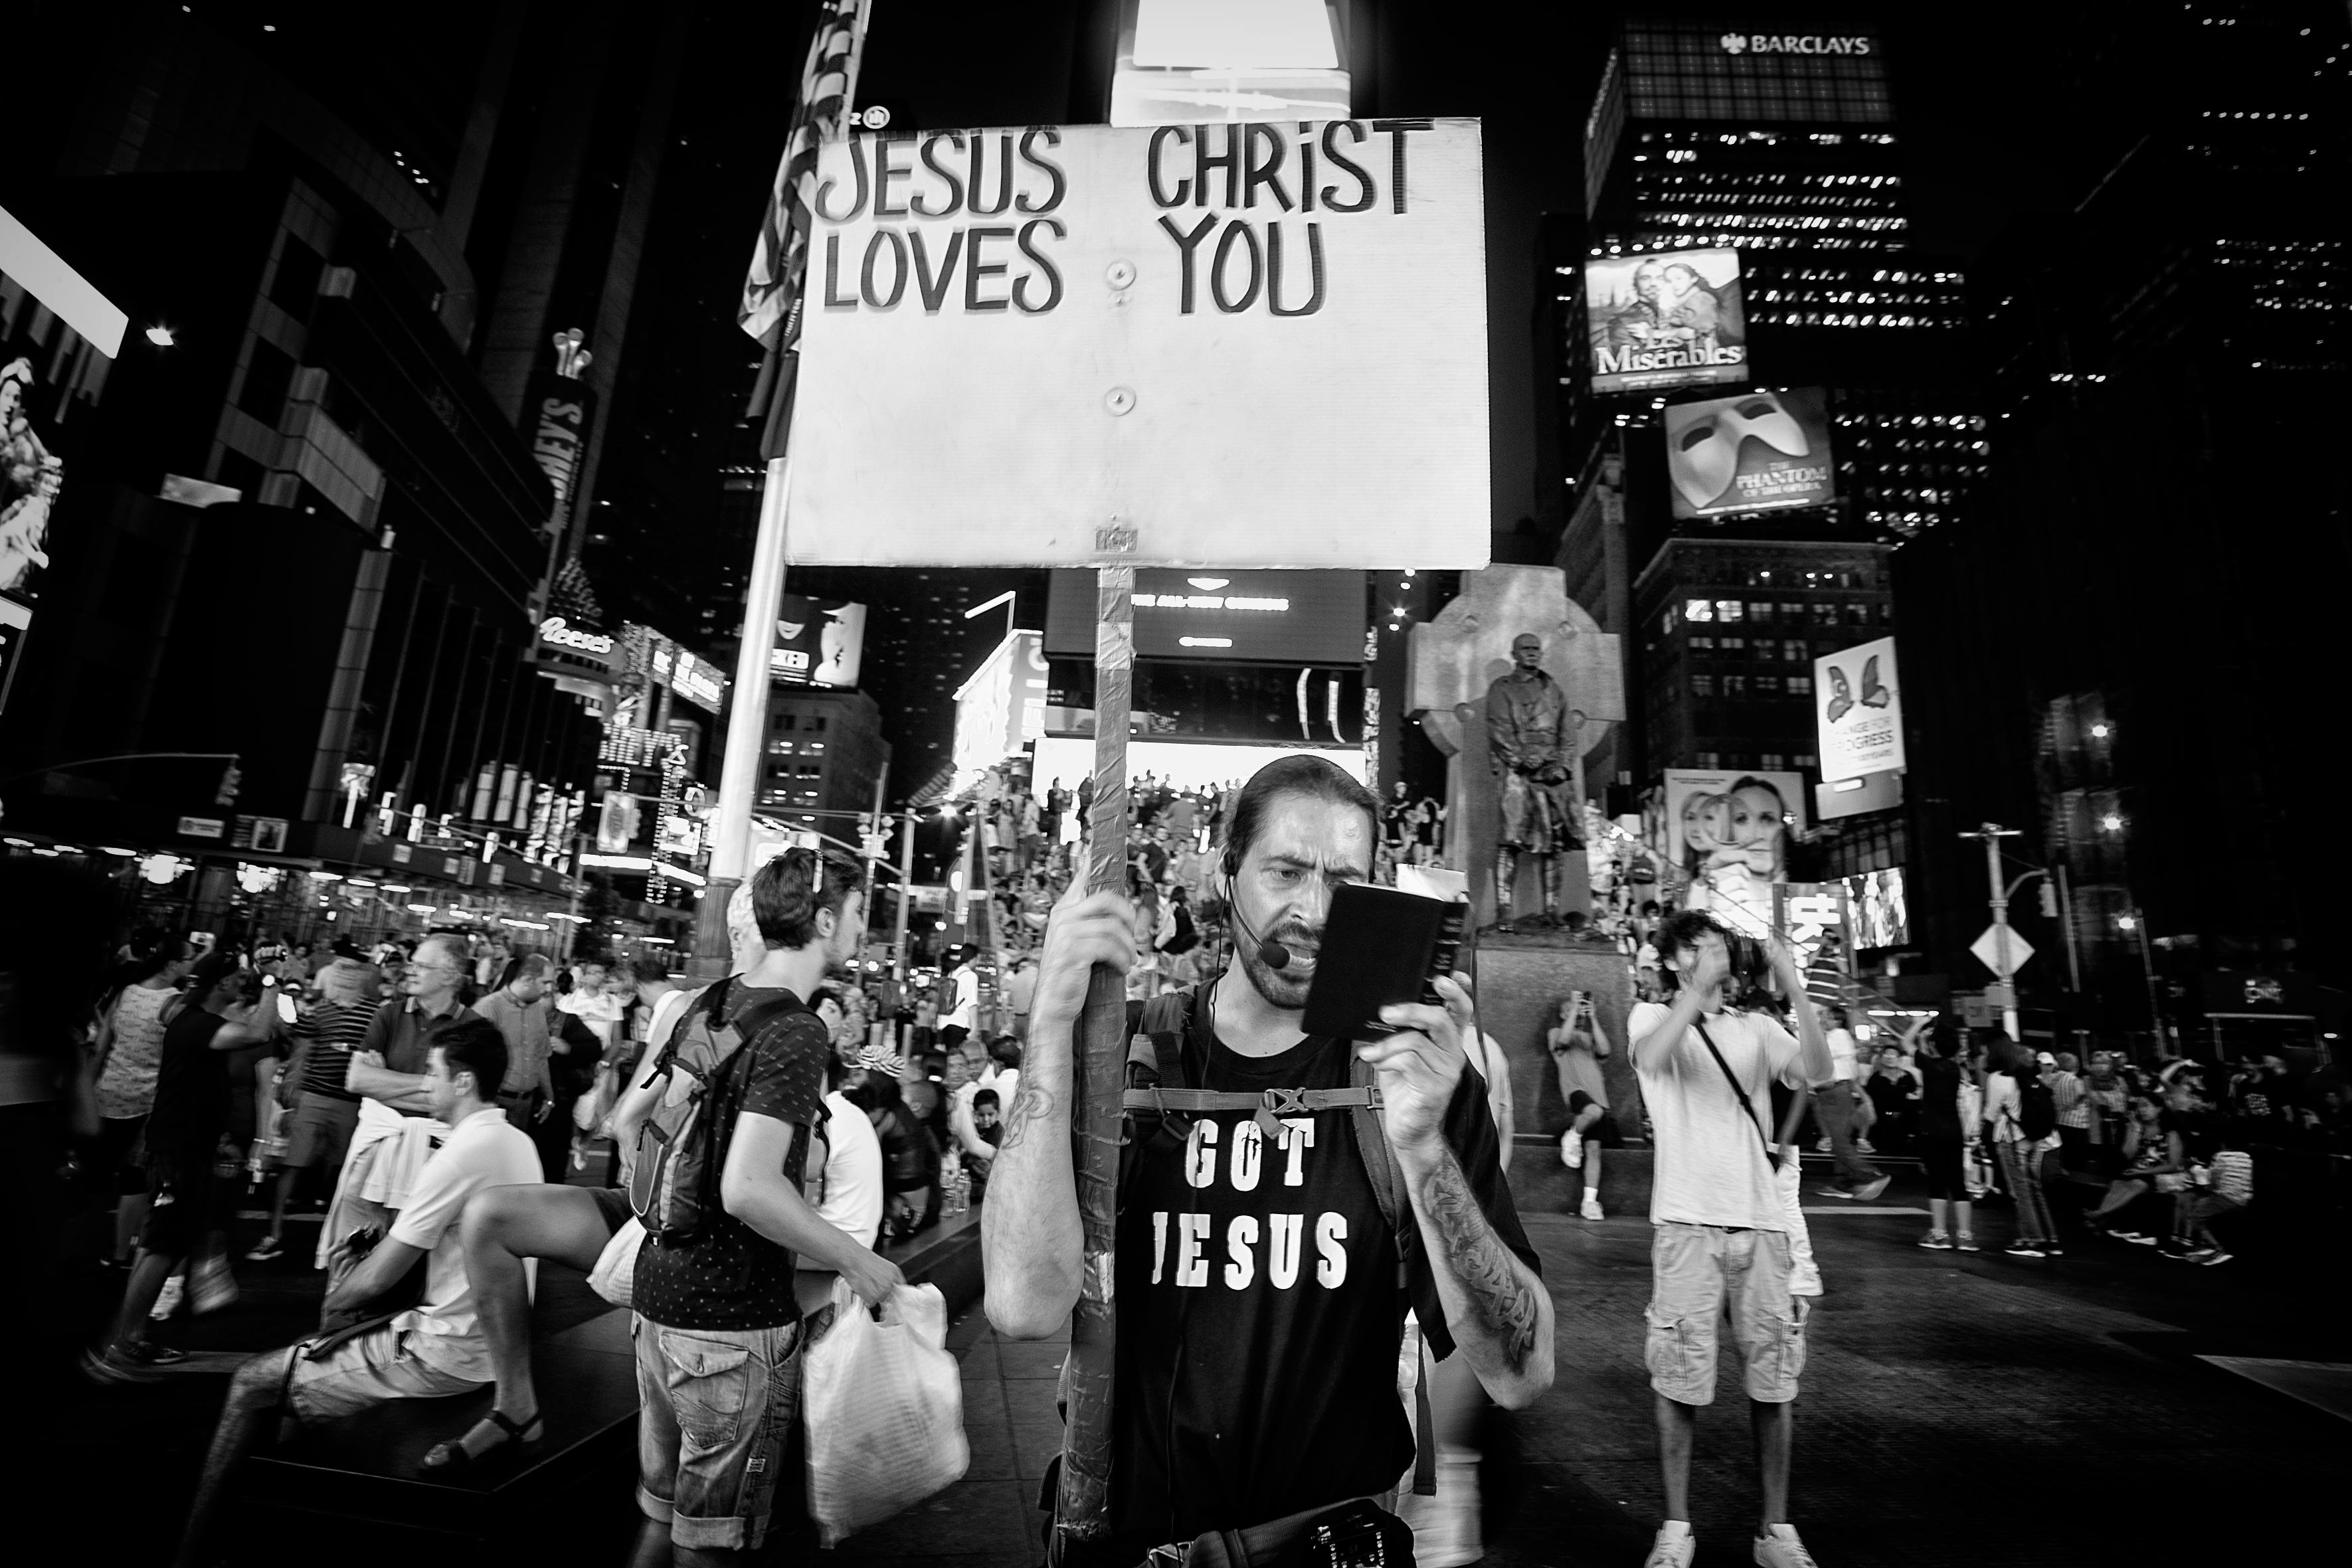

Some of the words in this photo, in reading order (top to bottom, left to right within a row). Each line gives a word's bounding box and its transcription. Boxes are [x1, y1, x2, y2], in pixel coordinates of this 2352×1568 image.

[1752, 35, 1870, 54] BARCLAYS
[815, 126, 1066, 221] JESUS
[825, 219, 1067, 313] LOVES
[1157, 211, 1327, 316] YOU
[1595, 337, 1743, 374] Misérables
[1735, 466, 1827, 489] PHANTOM
[1831, 730, 1894, 751] OGRESS
[1185, 1118, 1315, 1191] GOT
[1151, 1211, 1348, 1290] JESUS
